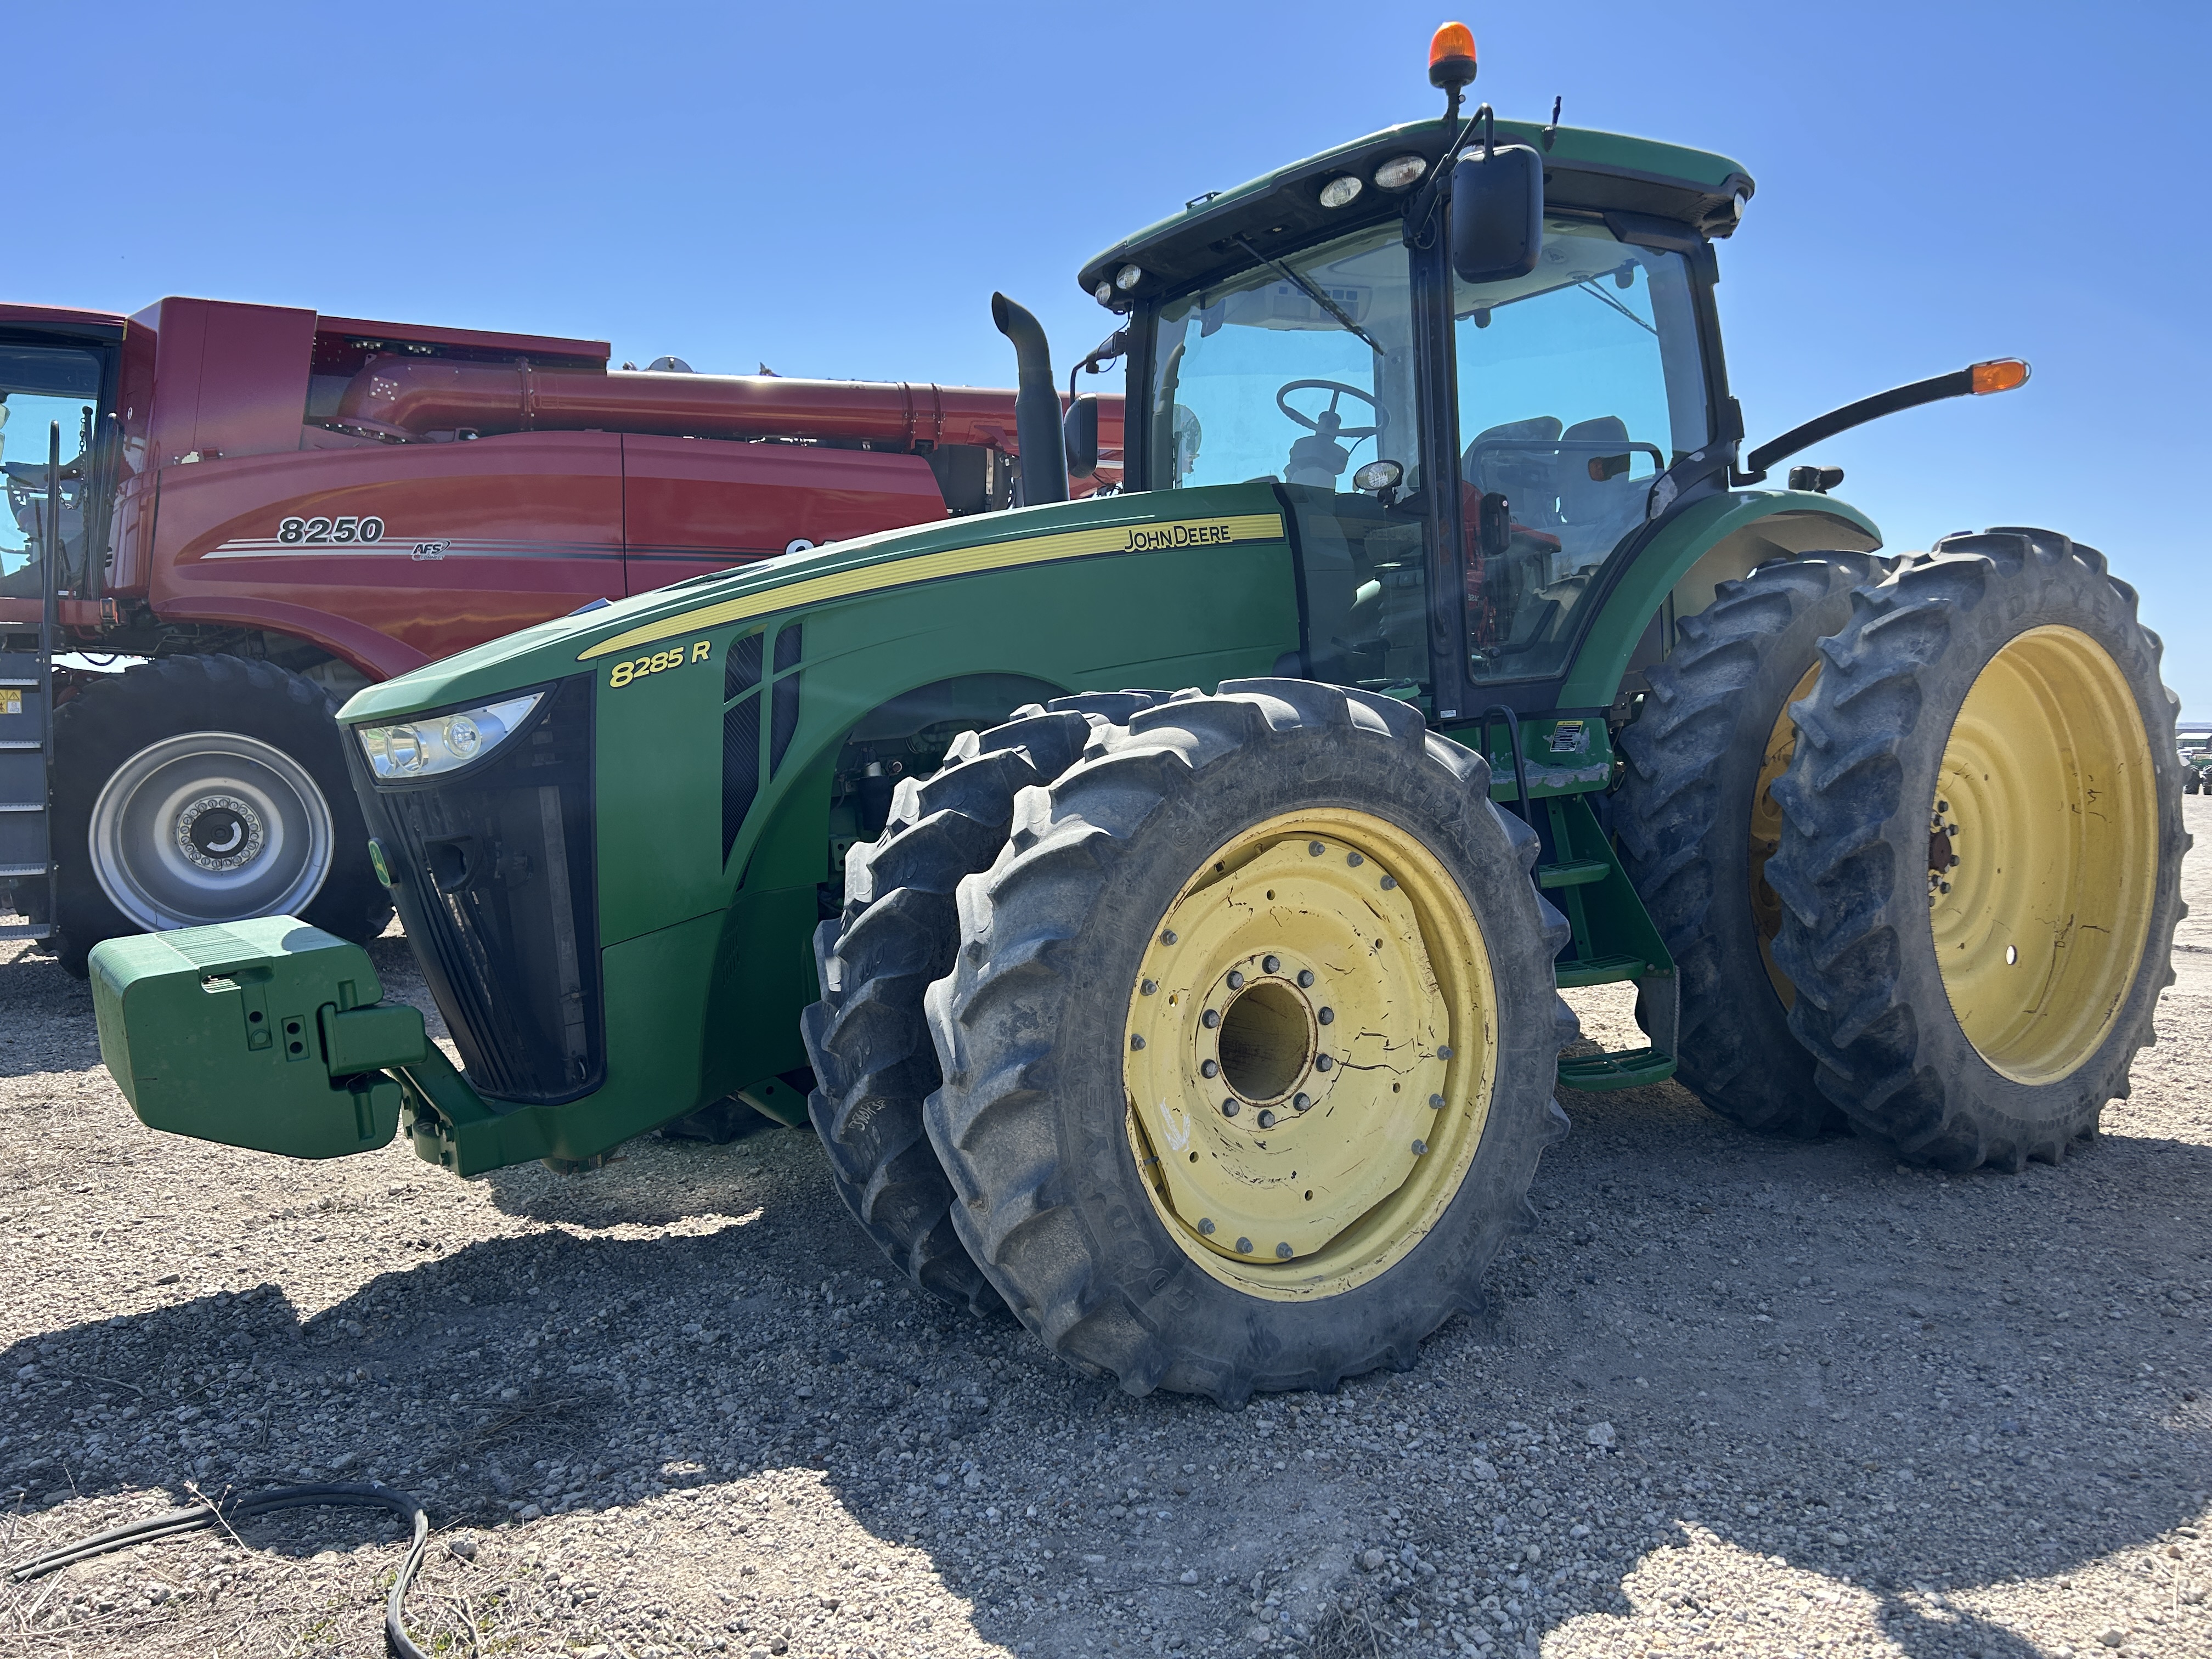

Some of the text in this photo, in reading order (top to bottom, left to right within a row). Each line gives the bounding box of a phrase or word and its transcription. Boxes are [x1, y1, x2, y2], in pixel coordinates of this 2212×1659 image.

[277, 516, 385, 545] 8250
[413, 544, 442, 555] AFS
[1124, 524, 1232, 551] JOHN DEERE
[610, 640, 712, 689] 8285 R
[1937, 582, 2149, 716] GOODYEAR
[1080, 977, 1200, 1320] GOODYEAR
